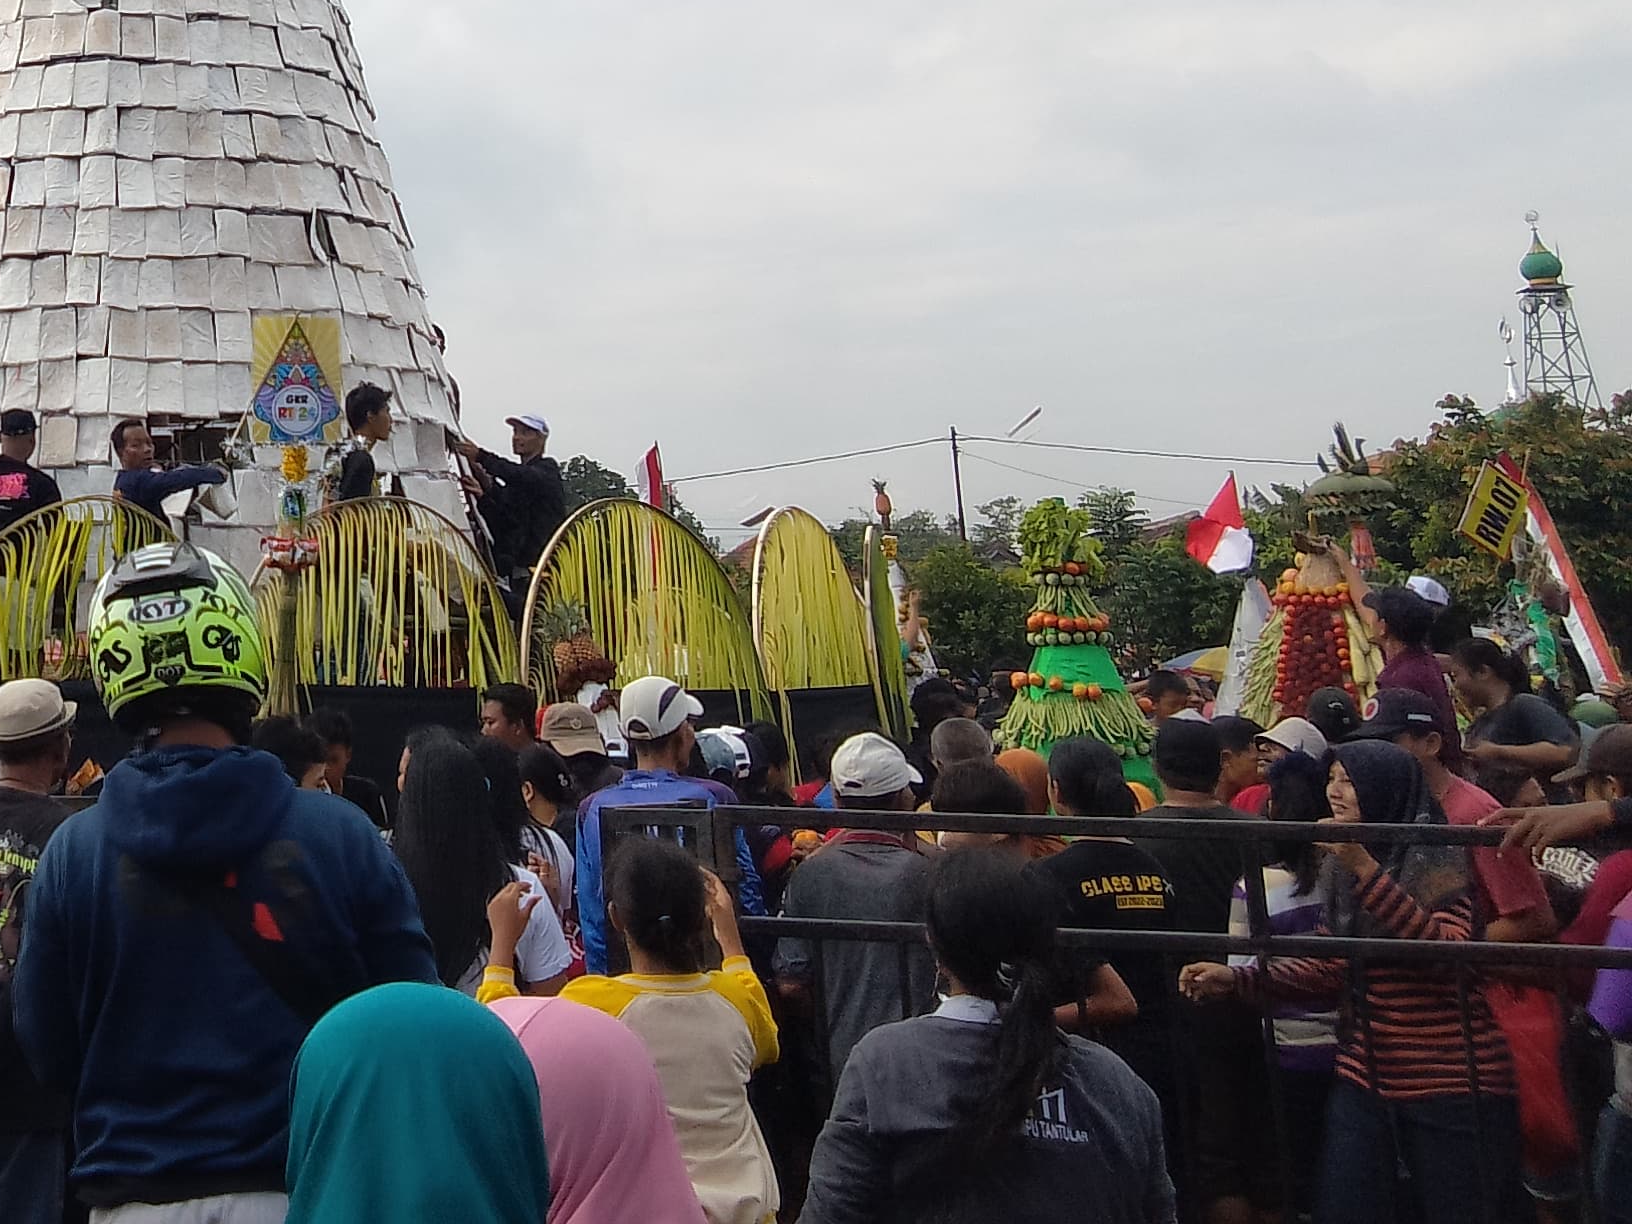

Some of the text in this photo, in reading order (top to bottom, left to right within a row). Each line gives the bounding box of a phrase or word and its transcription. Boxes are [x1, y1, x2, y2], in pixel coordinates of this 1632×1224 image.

[1475, 475, 1520, 548] RW.07
[1081, 875, 1163, 897] CLASS IPS
[1039, 1120, 1088, 1143] TANTULAR
